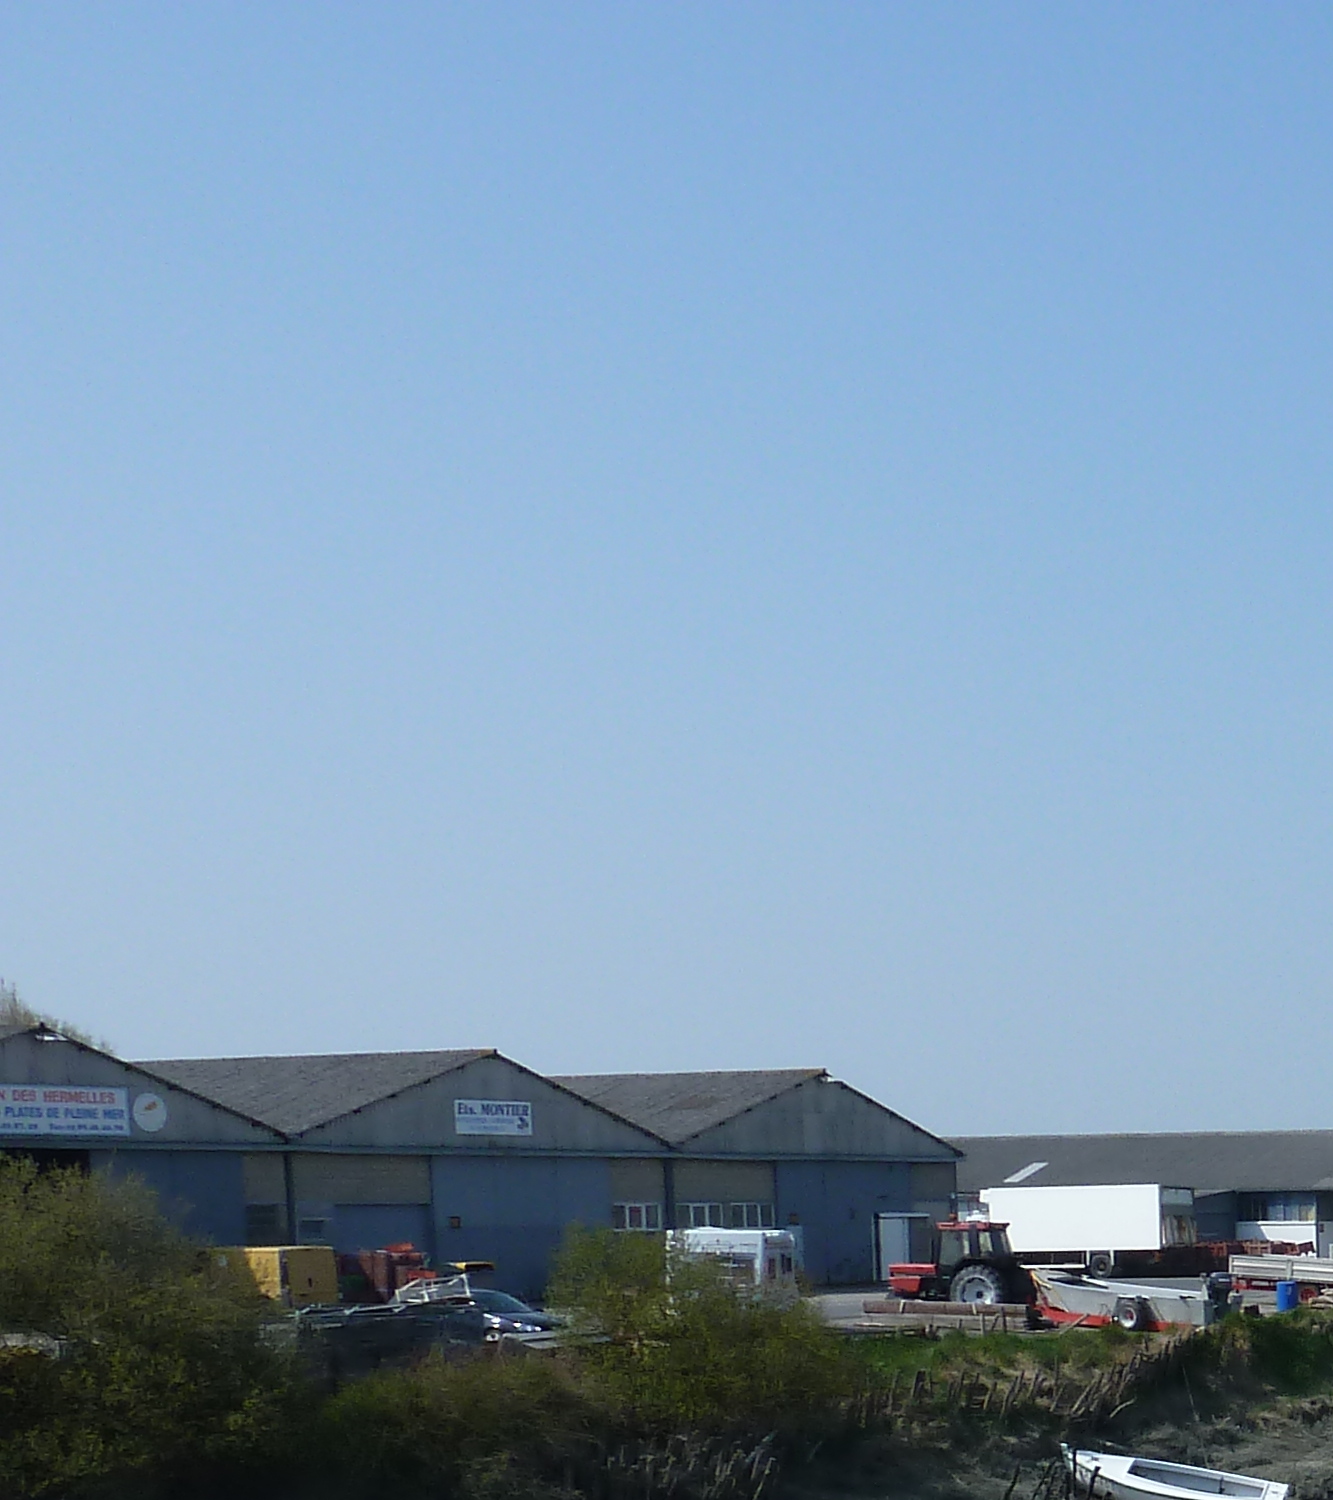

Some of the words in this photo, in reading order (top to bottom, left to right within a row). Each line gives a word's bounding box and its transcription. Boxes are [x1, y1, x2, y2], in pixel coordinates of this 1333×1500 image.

[12, 1089, 37, 1102] DES
[43, 1090, 116, 1104] HERMELLES
[481, 1103, 529, 1116] MONTIER
